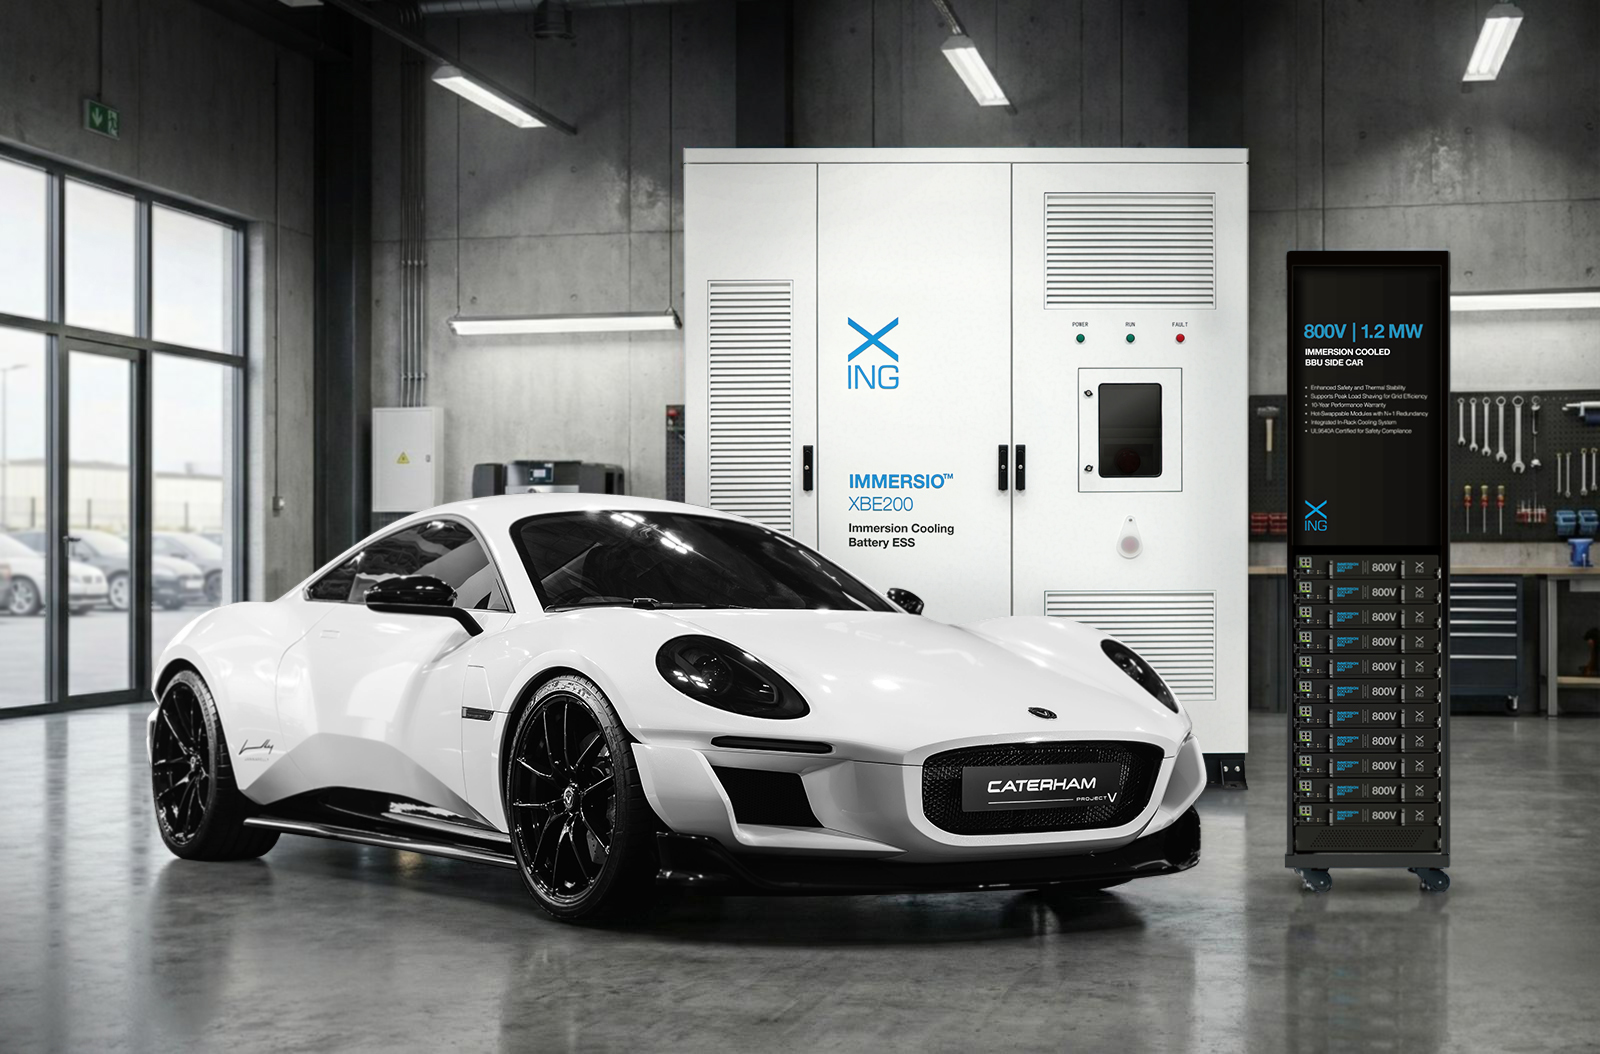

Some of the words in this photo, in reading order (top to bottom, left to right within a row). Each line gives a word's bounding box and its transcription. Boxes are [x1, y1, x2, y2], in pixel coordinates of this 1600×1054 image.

[1303, 323, 1347, 339] 800V
[1360, 323, 1385, 339] 1.2
[1388, 323, 1424, 339] MW
[1304, 347, 1354, 356] IMMERSION
[1354, 347, 1391, 356] COOLED
[1304, 358, 1323, 367] BBU
[1324, 358, 1344, 367] SIDE
[1344, 358, 1364, 367] CAR
[847, 365, 900, 390] ING
[848, 496, 914, 512] XBE200
[848, 522, 908, 534] Immersion
[911, 522, 955, 536] Cooling
[1304, 520, 1328, 532] ING
[848, 537, 889, 550] Battery
[892, 537, 916, 548] ESS
[1371, 562, 1397, 573] 800V
[1371, 587, 1397, 598] 800V
[1371, 612, 1397, 623] 800V
[1371, 636, 1397, 647] 800V
[1371, 661, 1397, 672] 800V
[1371, 686, 1397, 697] 800V
[1371, 711, 1397, 722] 800V
[1371, 736, 1397, 747] 800V
[1371, 760, 1397, 771] 800V
[987, 776, 1097, 794] CATERHAM
[1371, 785, 1397, 796] 800V
[1107, 792, 1118, 803] V
[1371, 810, 1397, 821] 800V
